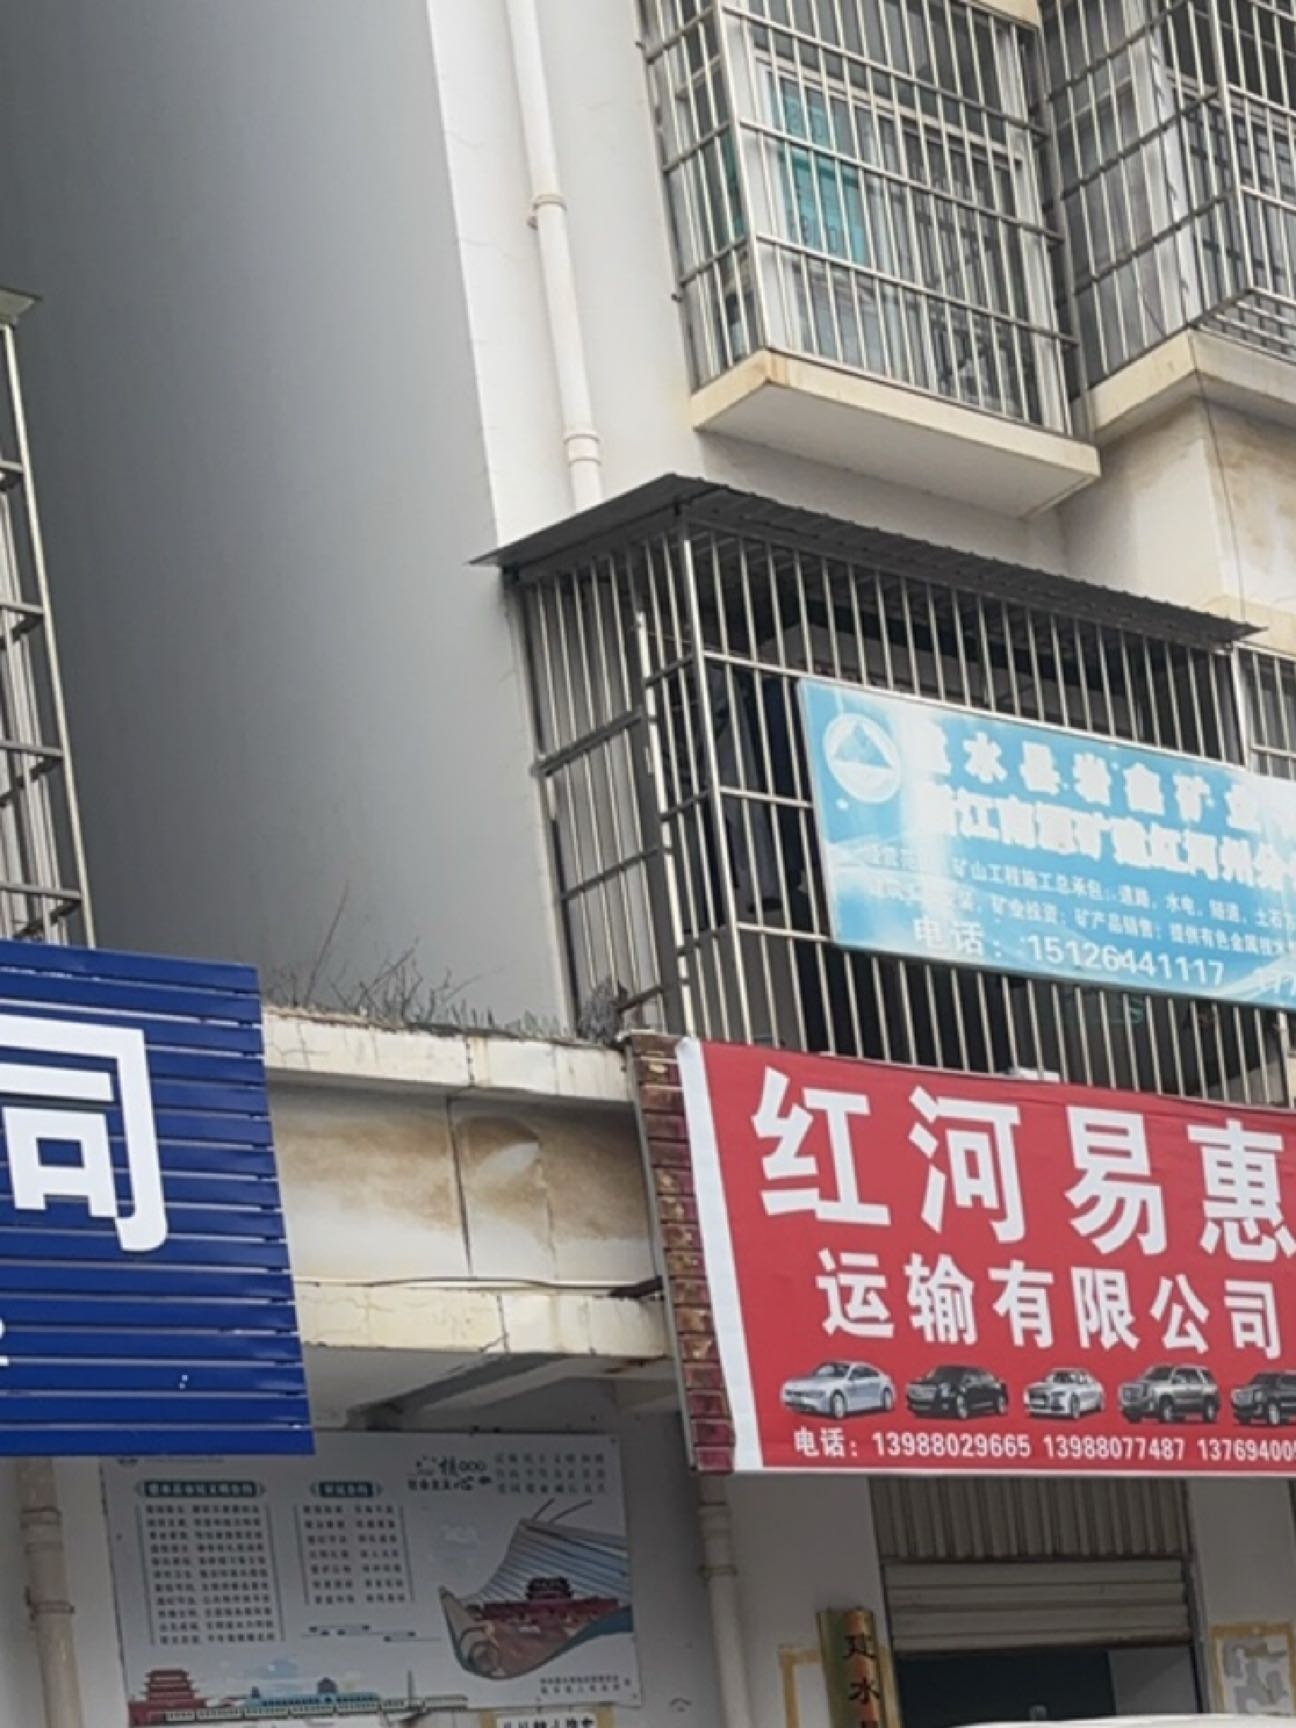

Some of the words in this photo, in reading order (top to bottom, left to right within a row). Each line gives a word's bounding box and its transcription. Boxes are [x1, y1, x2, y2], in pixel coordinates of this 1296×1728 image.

[1028, 934, 1224, 986] 15126441117
[0, 1014, 168, 1250] 司
[816, 1248, 1282, 1361] 运输有限公司
[794, 1428, 858, 1460] 电话：
[872, 1431, 1032, 1460] 13988029665
[1044, 1437, 1186, 1462] 13988077487
